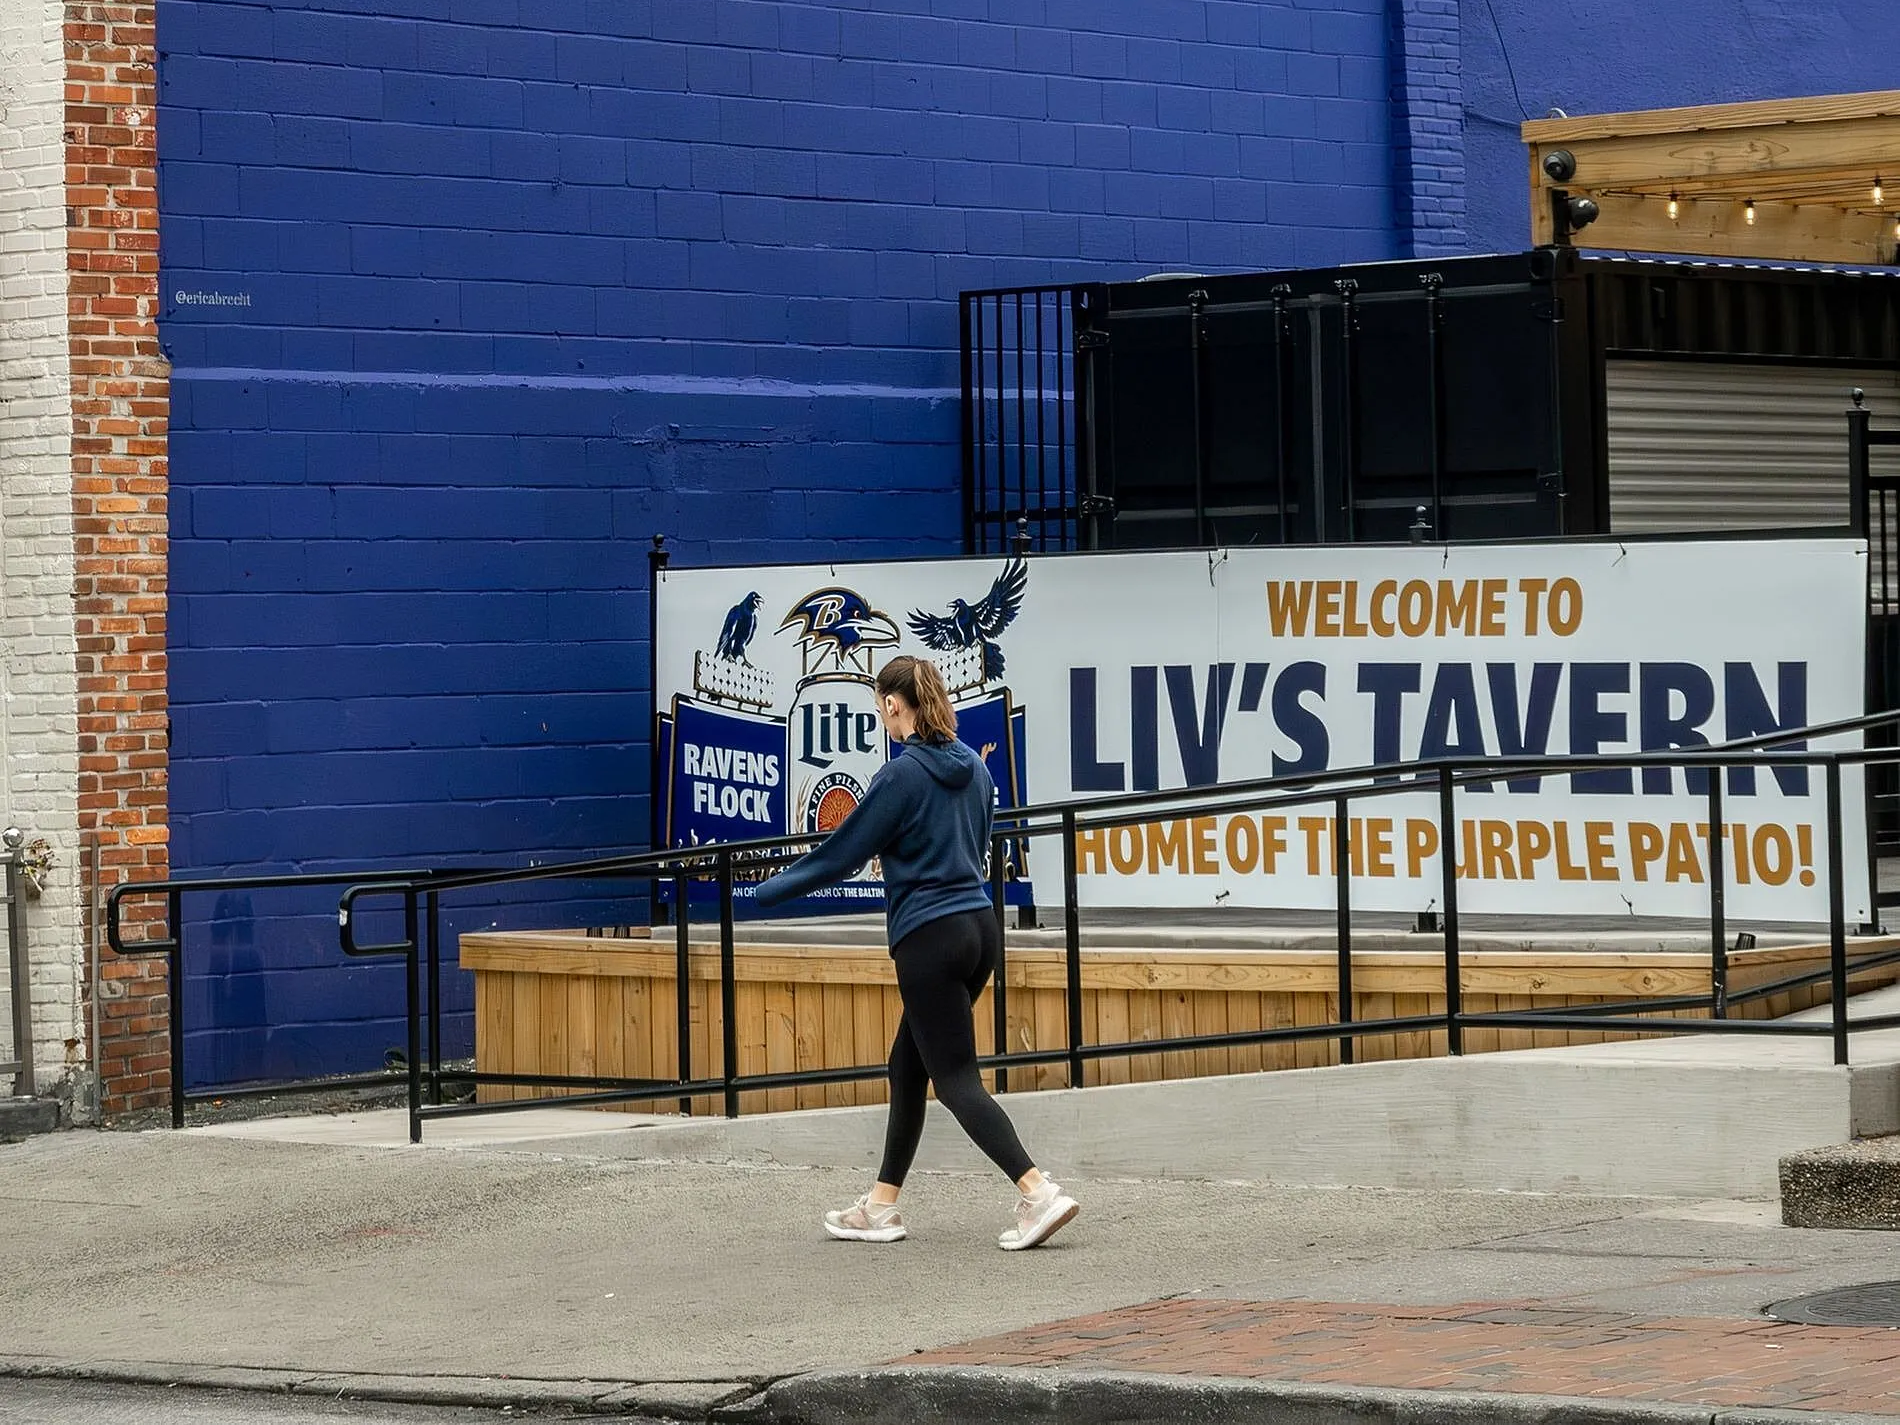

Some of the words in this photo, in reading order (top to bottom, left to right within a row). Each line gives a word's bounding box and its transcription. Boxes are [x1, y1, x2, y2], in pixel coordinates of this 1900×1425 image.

[1266, 578, 1508, 637] WELCOME
[1518, 577, 1584, 637] TO
[798, 702, 877, 770] Lite
[1069, 660, 1331, 792] LIV'S
[1356, 660, 1811, 796] TAVERN
[684, 743, 780, 787] RAVENS
[811, 777, 833, 805] FINE
[835, 775, 865, 800] PILSN
[693, 781, 772, 823] FLOCK
[1074, 815, 1221, 876] HOME
[1225, 814, 1288, 875] OF
[1297, 816, 1395, 877] THE
